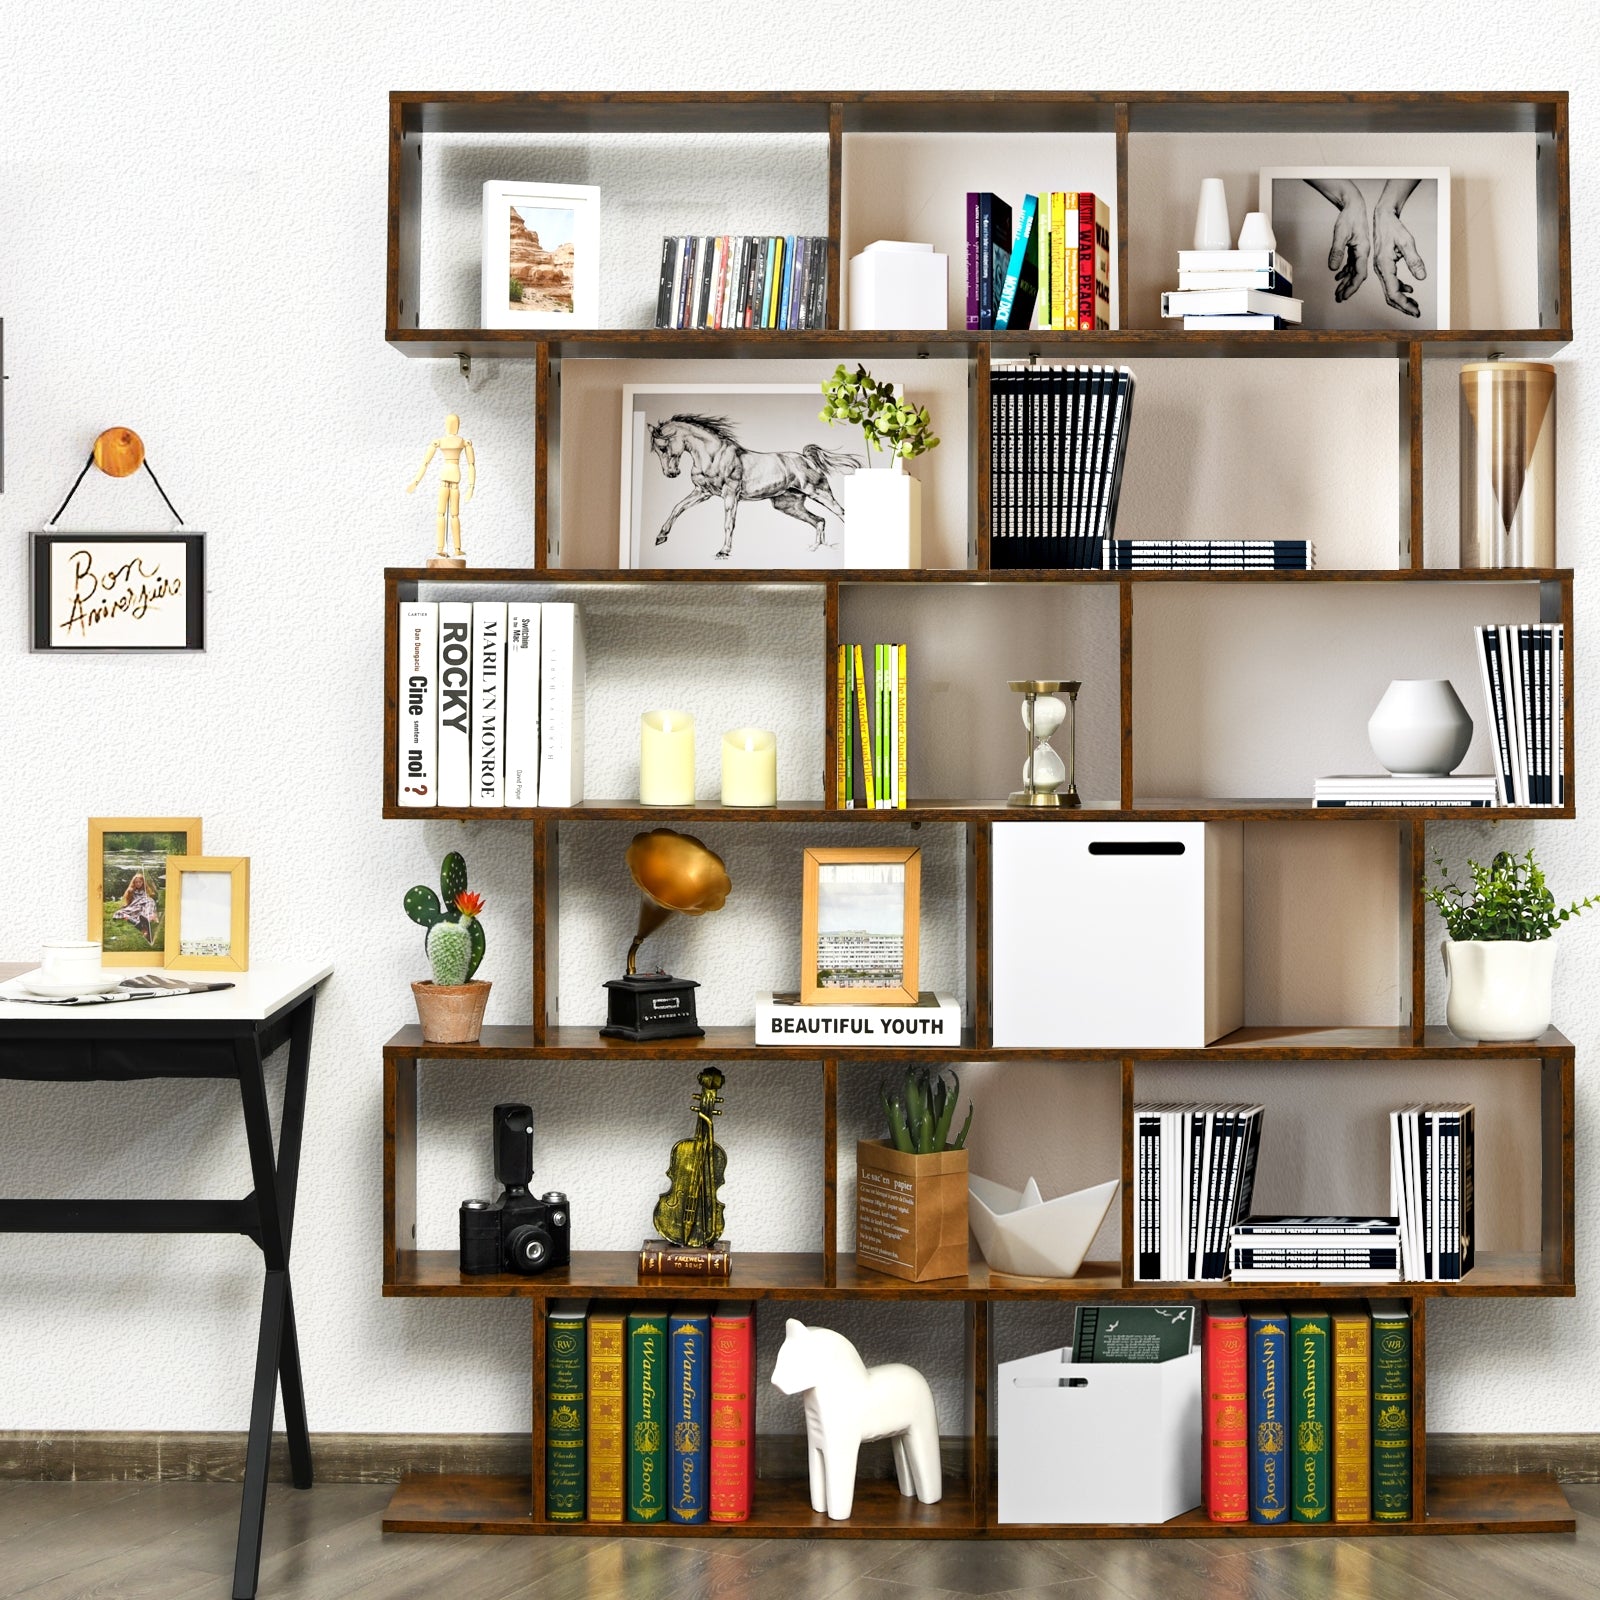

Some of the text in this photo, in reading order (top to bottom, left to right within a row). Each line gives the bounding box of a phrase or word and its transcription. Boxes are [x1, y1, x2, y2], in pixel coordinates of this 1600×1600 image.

[1080, 230, 1092, 260] WAR
[996, 274, 1017, 322] MOBY DICK
[1080, 274, 1092, 317] PEACE
[68, 550, 160, 602] Bon
[520, 618, 530, 649] Switching
[413, 642, 421, 672] Dungaciu
[408, 676, 428, 716] Cine
[443, 623, 468, 734] ROCKY
[856, 676, 865, 695] The
[481, 622, 497, 798] MARILYN MONROE
[858, 697, 868, 733] Murder
[837, 676, 845, 783] The Murder Quadrille
[408, 750, 427, 778] noi
[772, 1018, 943, 1034] BEAUTIFUL YOUTH
[861, 1168, 871, 1180] Le
[894, 1180, 913, 1191] papier
[557, 1340, 573, 1349] RW
[720, 1340, 736, 1349] RW
[641, 1338, 656, 1507] Wandian Book
[681, 1338, 696, 1508] Wandian Book
